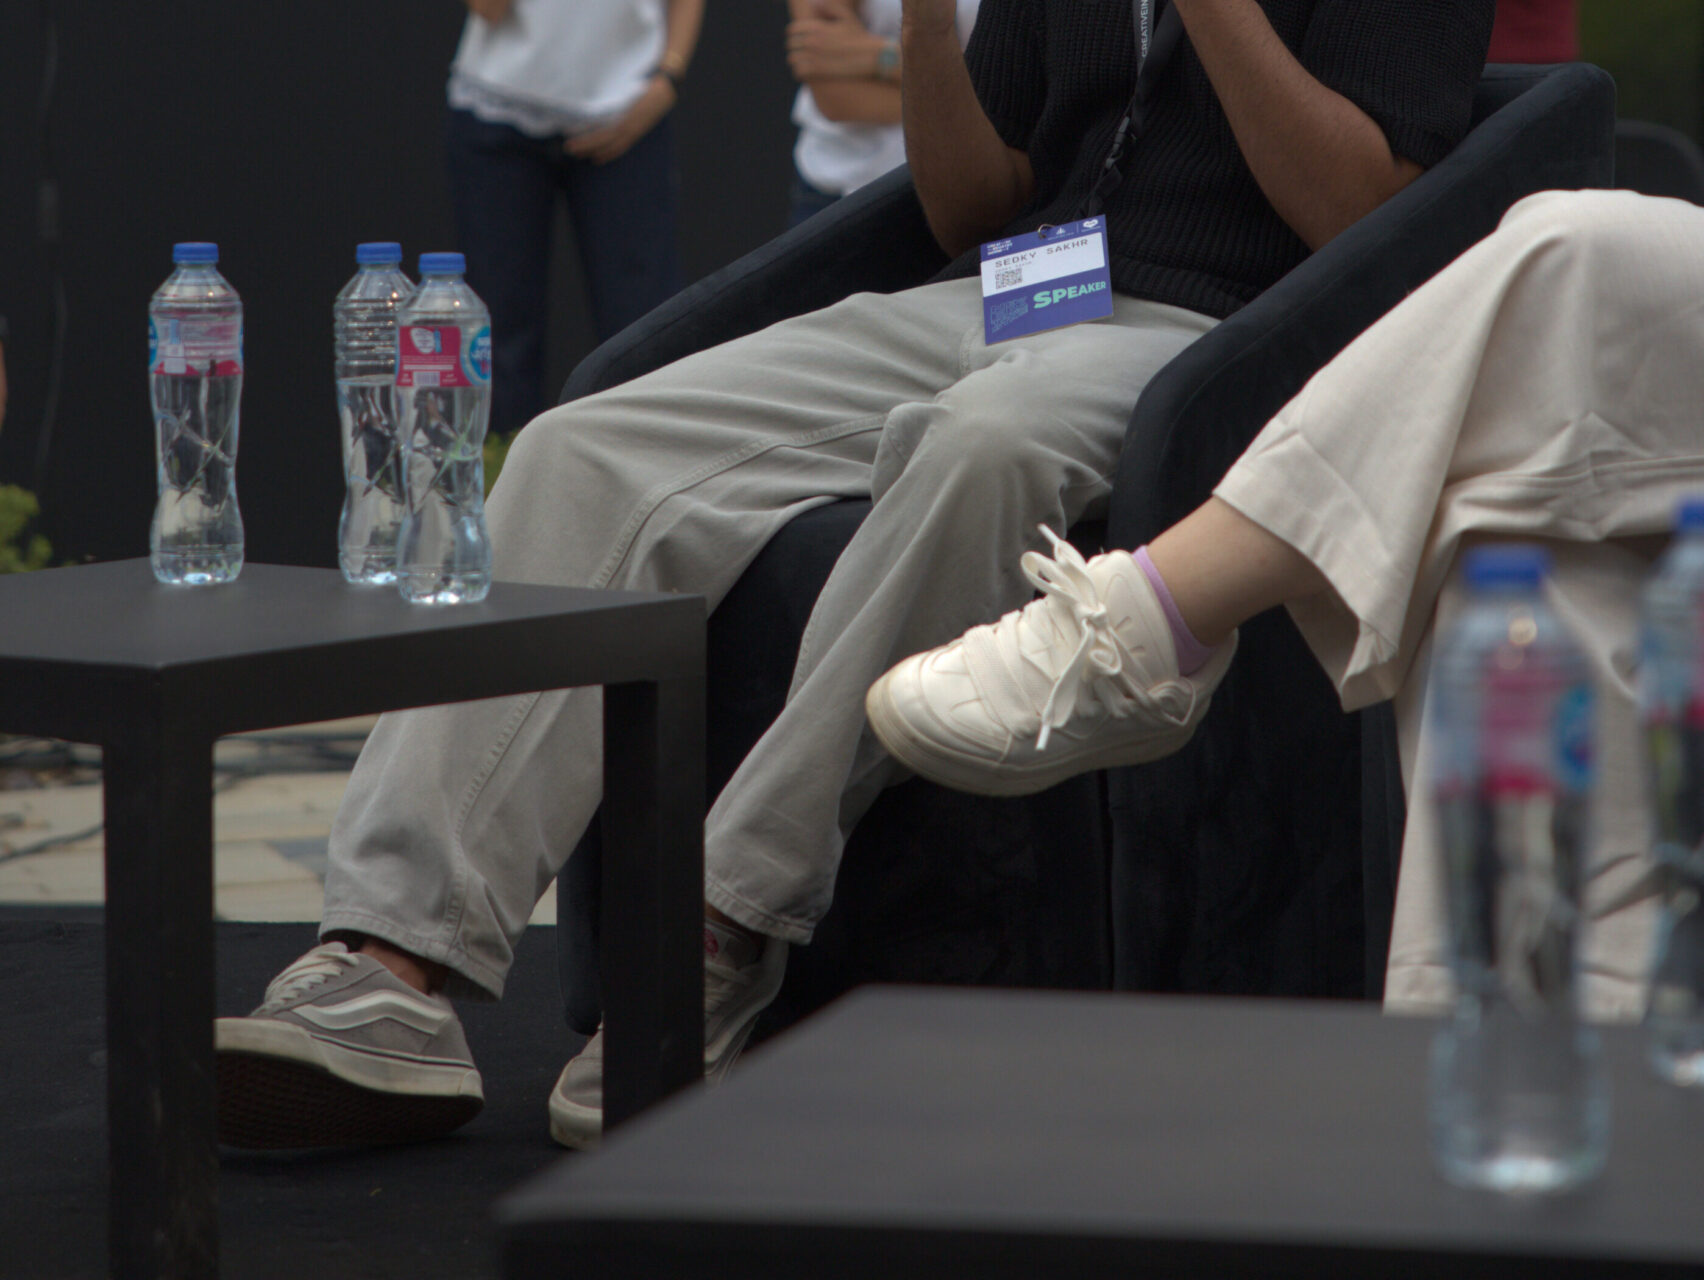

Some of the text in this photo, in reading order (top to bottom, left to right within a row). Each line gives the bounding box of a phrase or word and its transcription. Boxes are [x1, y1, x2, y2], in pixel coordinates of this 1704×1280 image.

[994, 251, 1037, 268] SEDKY
[1046, 238, 1089, 255] SAKHR
[1033, 281, 1107, 309] SPEAKER
